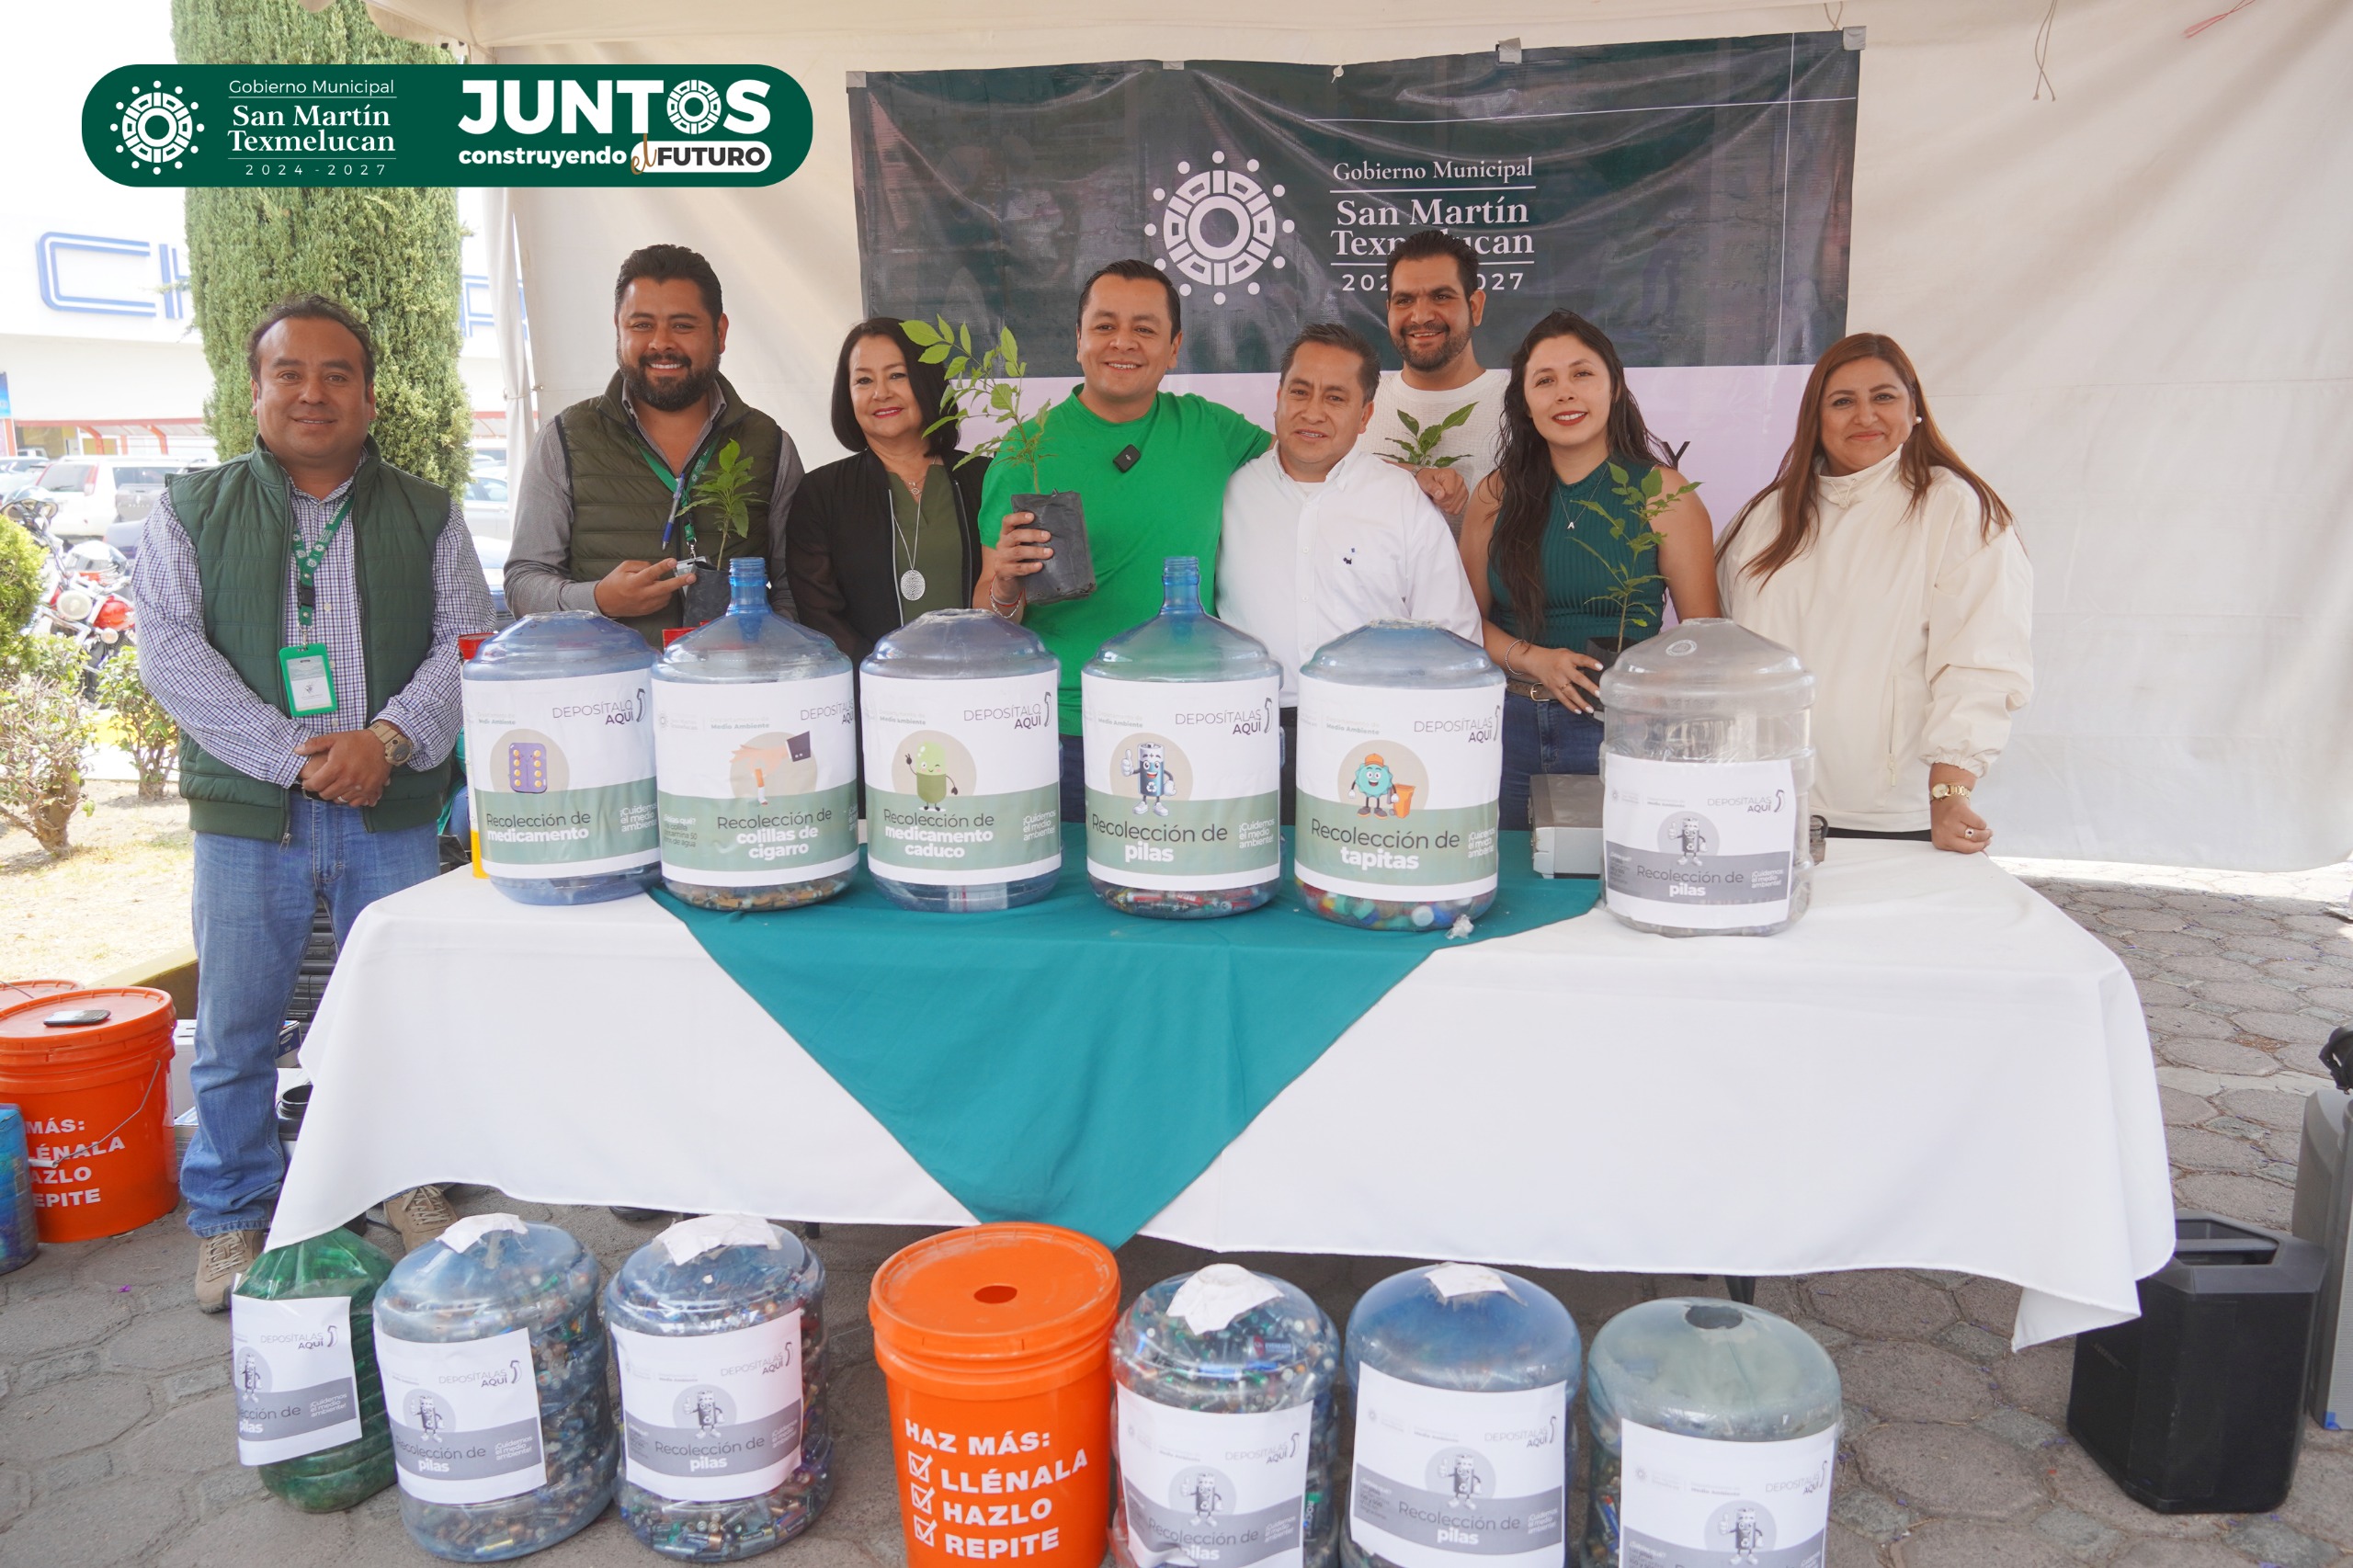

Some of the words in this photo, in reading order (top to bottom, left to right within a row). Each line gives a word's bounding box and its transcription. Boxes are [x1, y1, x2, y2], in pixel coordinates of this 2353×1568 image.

[1333, 160, 1427, 180] Gobierno
[1433, 156, 1533, 184] Municipal
[1336, 199, 1400, 226] San
[1409, 196, 1529, 225] Martín
[552, 699, 632, 718] DEPOSÍTALO
[842, 710, 853, 724] AQU
[1176, 709, 1261, 725] DEPOSÍTALAS
[1415, 717, 1493, 733] DEPOSÍTALAS
[487, 813, 566, 827] Recolección
[572, 812, 591, 824] de
[717, 812, 813, 830] Recolección
[816, 808, 832, 822] de
[883, 809, 969, 828] Recolección
[973, 812, 995, 826] de
[1092, 813, 1195, 843] Recolección
[1201, 824, 1228, 841] de
[487, 827, 589, 843] medicamento
[736, 827, 795, 845] colillas
[799, 825, 818, 839] de
[885, 826, 994, 843] medicamento
[1312, 818, 1428, 849] Recolección
[1435, 830, 1460, 848] de
[748, 843, 809, 860] cigarro
[904, 843, 964, 858] caduco
[1125, 841, 1174, 863] pilas
[1340, 846, 1419, 870] tapitas
[1636, 866, 1721, 883] Recolección
[1724, 871, 1744, 883] de
[1669, 881, 1706, 897] pilas
[26, 1118, 85, 1134] MÁS:
[30, 1166, 92, 1184] AZLO
[34, 1187, 101, 1208] EPITE
[281, 1406, 301, 1417] de
[655, 1440, 742, 1456] Recolección
[745, 1437, 765, 1450] de
[904, 1418, 957, 1453] HAZ
[968, 1430, 1050, 1456] MÁS:
[466, 1447, 486, 1459] de
[418, 1458, 449, 1472] pilas
[689, 1456, 728, 1471] pilas
[940, 1449, 1087, 1494] LLÉNALA
[943, 1497, 1051, 1526] HAZLO
[1398, 1501, 1496, 1530] Recolección
[1500, 1517, 1520, 1530] de
[1149, 1517, 1236, 1546] Recolección
[1240, 1529, 1258, 1543] de
[1437, 1527, 1479, 1545] pilas
[945, 1527, 1059, 1560] REPITE
